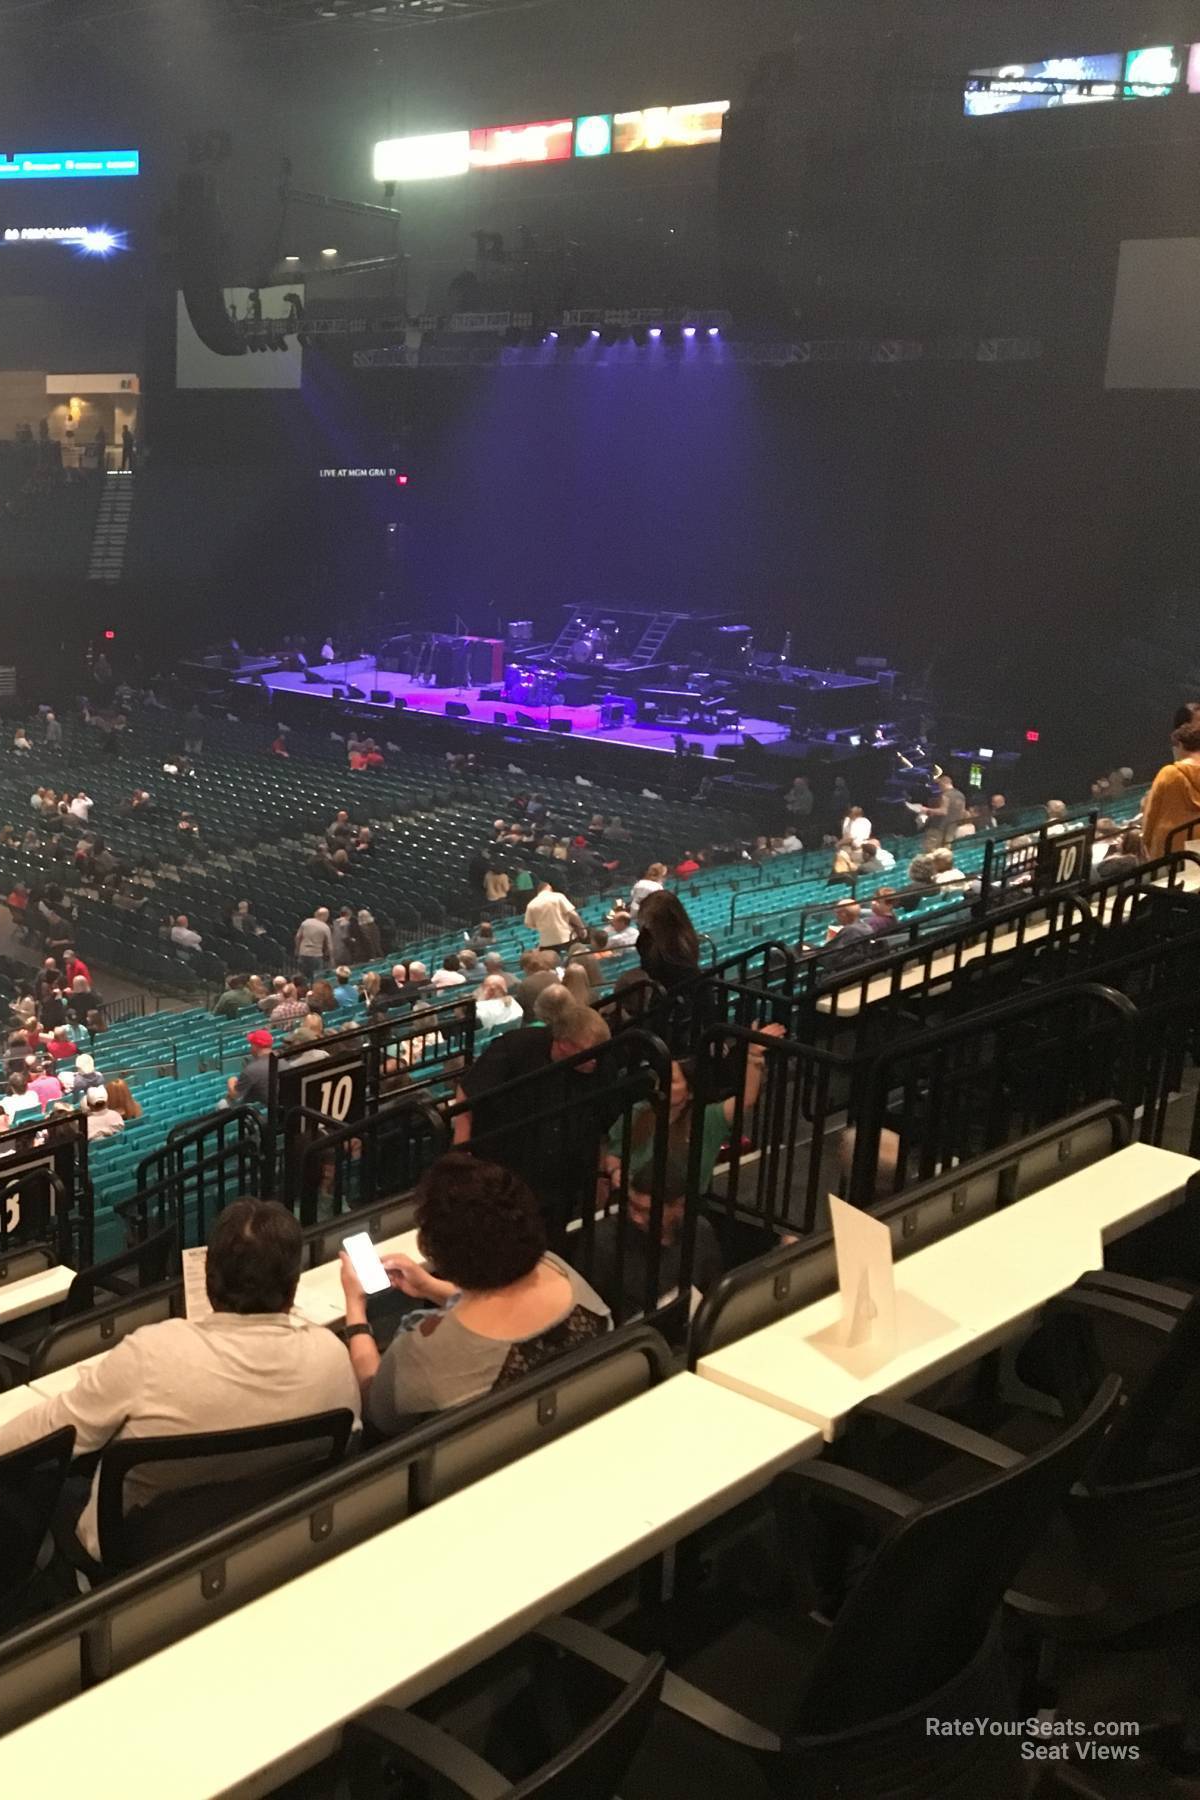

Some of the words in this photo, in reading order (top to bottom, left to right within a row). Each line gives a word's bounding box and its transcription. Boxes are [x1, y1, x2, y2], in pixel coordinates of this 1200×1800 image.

[319, 469, 336, 477] LIVE
[337, 469, 347, 477] AT
[348, 468, 367, 477] MGM
[1055, 846, 1077, 884] 10
[318, 1075, 353, 1127] 10
